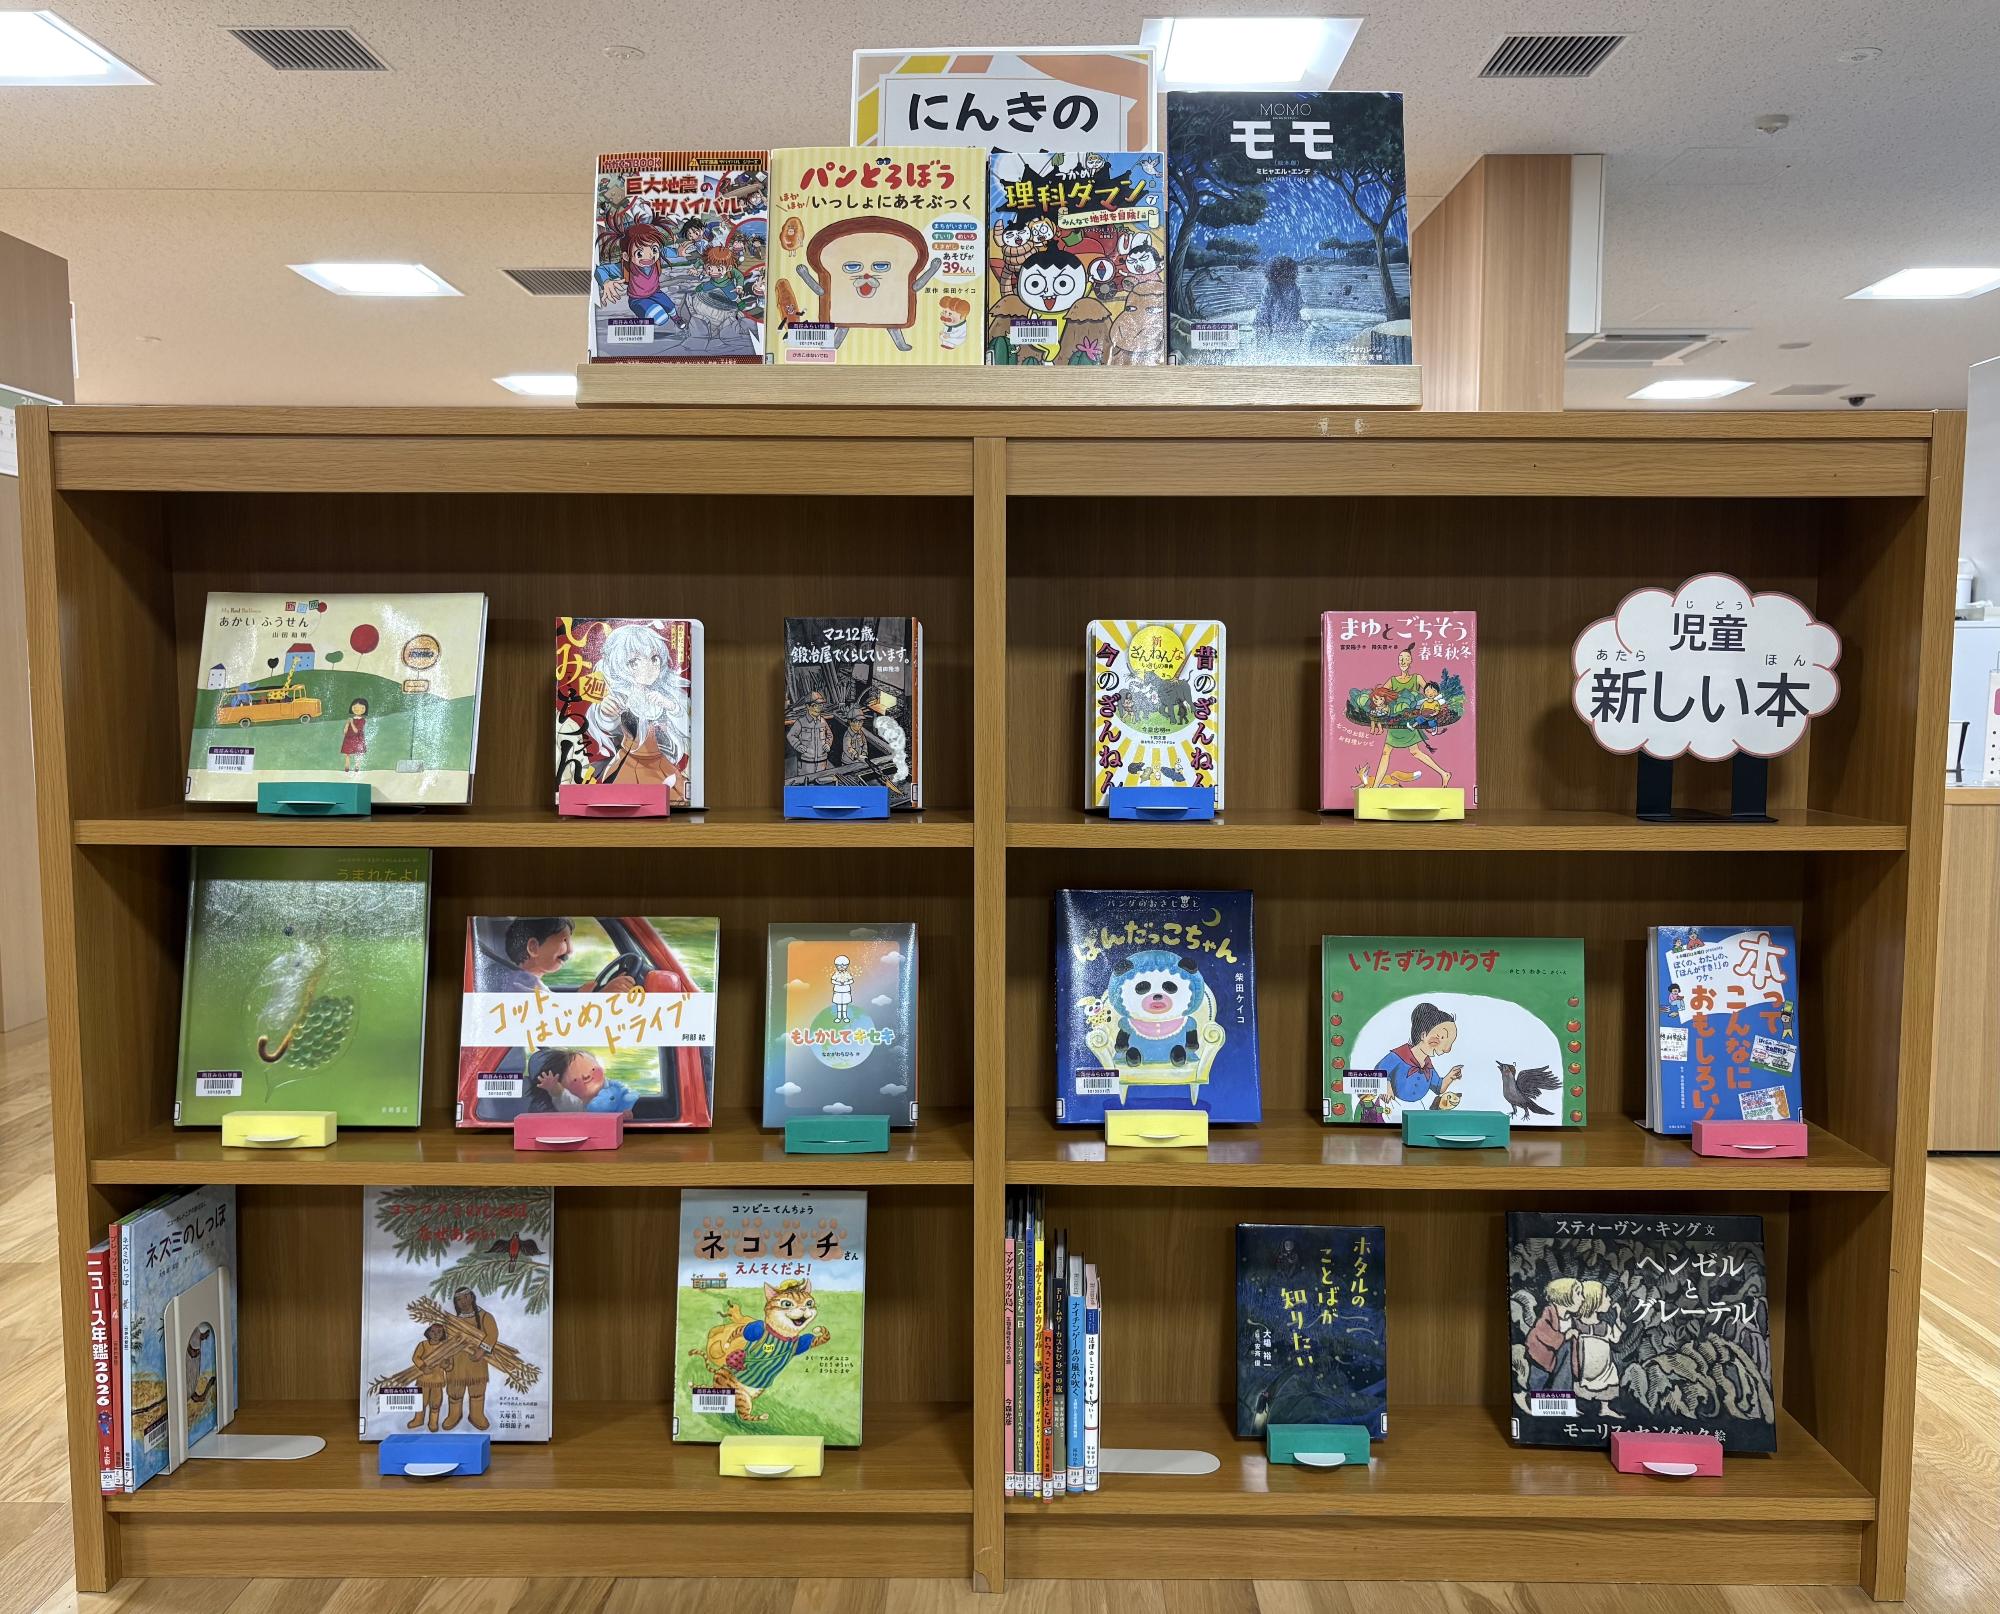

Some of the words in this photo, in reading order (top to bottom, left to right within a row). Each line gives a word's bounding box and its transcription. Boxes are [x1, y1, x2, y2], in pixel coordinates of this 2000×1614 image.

[908, 91, 1099, 133] にんきの
[1260, 103, 1311, 116] MOMO
[1230, 120, 1334, 160] モモ
[626, 176, 713, 195] 巨大地震の
[800, 159, 955, 190] パンどろぼう
[1055, 169, 1096, 181] つかめ!
[652, 196, 744, 215] サバイバル
[812, 194, 971, 210] いっしょにあそぶっく
[1006, 180, 1146, 212] 理科ダマン
[934, 223, 976, 231] まちがいさがし
[956, 233, 976, 241] めいろ
[943, 252, 974, 262] あそびが
[219, 616, 255, 627] あかい
[261, 616, 309, 627] ふうせん
[823, 626, 879, 642] マユ12歳、
[1340, 616, 1468, 641] まゆとごちそう
[1669, 613, 1748, 652] 児童
[791, 645, 910, 664] 鍛冶屋でくらしています。
[1130, 645, 1185, 663] ざんねんな
[1419, 644, 1472, 660] 春夏秋冬
[1596, 649, 1646, 662] あたら
[1764, 654, 1806, 666] ほん
[1590, 667, 1810, 728] 新しい本
[1097, 642, 1123, 794] 今のざんねん
[1191, 645, 1218, 787] 昔のざんねん
[1348, 948, 1500, 973] いたずらからす
[489, 985, 560, 1034] コット、
[1235, 972, 1246, 1024] 柴田ケイコ
[527, 985, 646, 1053] はじめての
[605, 992, 691, 1055] ドライブ
[791, 1028, 896, 1046] もしかしてキセキ
[1726, 985, 1753, 1089] こんなに
[732, 1203, 814, 1215] コンビニてんちょう
[146, 1203, 226, 1269] ネズミのしっぽ
[1555, 1219, 1702, 1237] スティーヴン・キング
[1704, 1224, 1715, 1236] 文
[736, 1262, 812, 1276] えんそくだよ!
[1351, 1236, 1371, 1308] ホタルの
[1637, 1252, 1745, 1278] ヘンゼル
[1005, 1251, 1013, 1312] マダガスカル島へ
[1318, 1248, 1339, 1325] ことばが
[1684, 1279, 1699, 1299] と
[1632, 1298, 1757, 1327] グレーテル
[86, 1260, 110, 1406] ニュース年鑑2026
[1281, 1288, 1314, 1367] 知りたい
